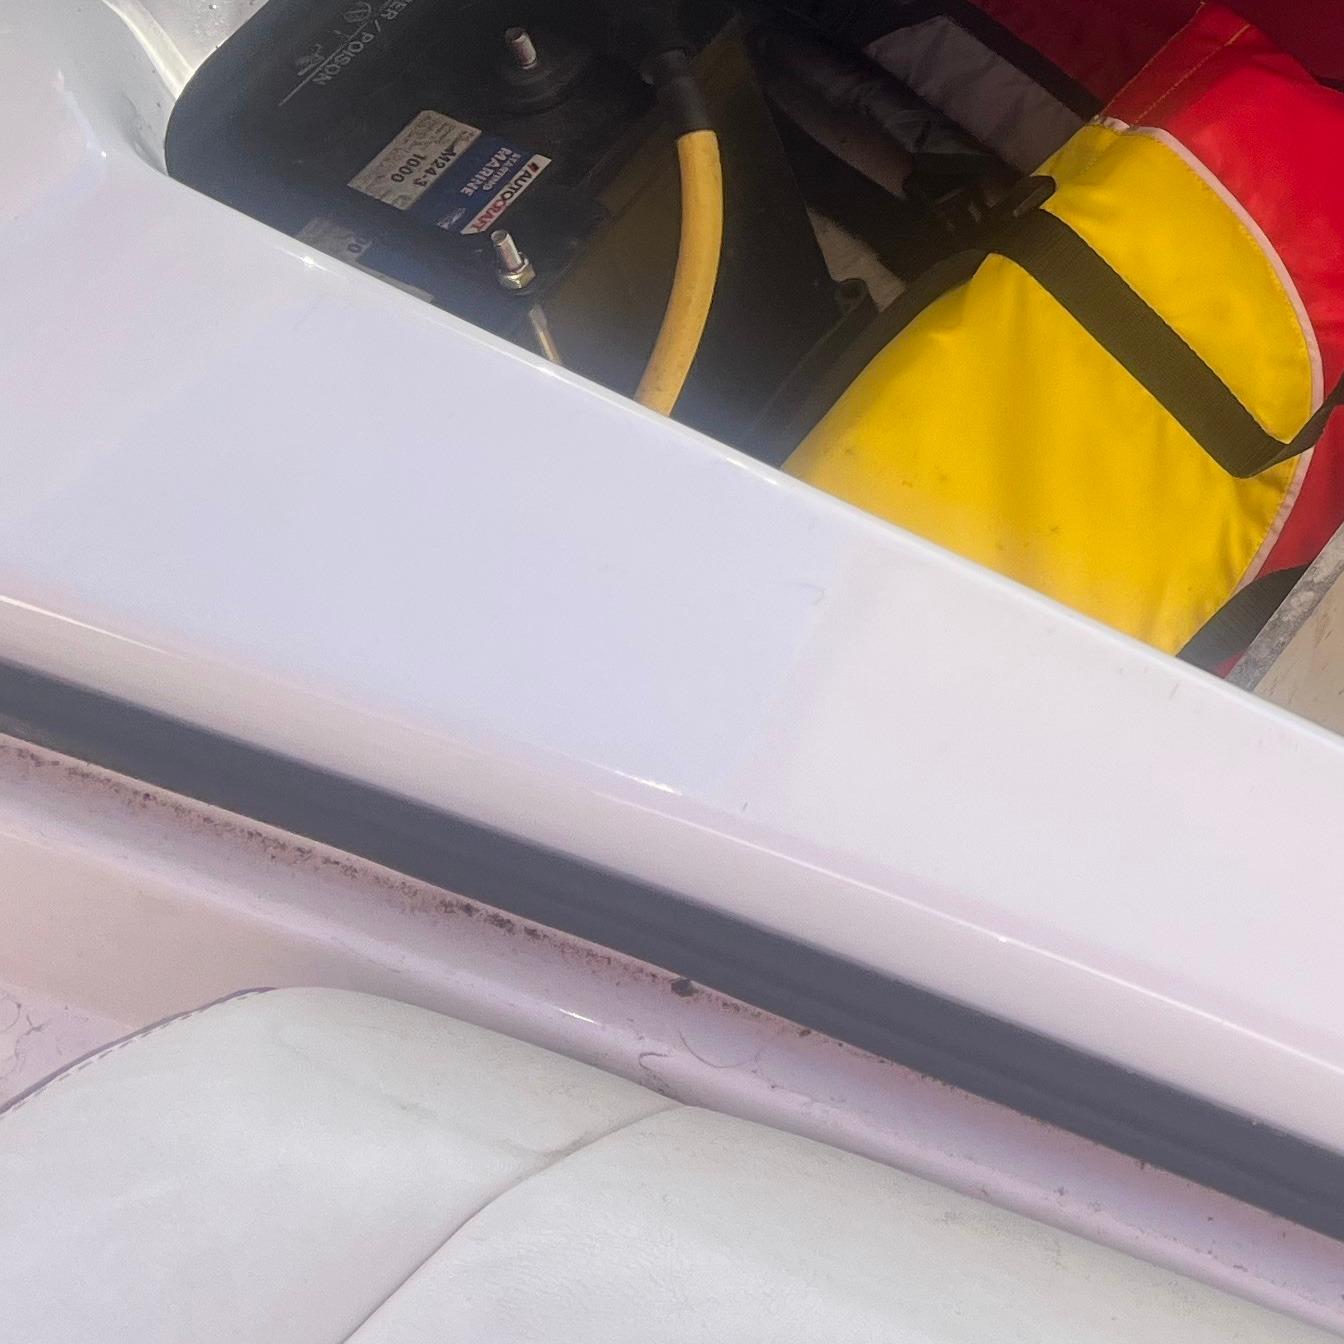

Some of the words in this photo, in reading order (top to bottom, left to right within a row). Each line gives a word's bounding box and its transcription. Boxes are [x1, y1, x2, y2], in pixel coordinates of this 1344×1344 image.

[312, 31, 376, 86] POISON
[391, 153, 426, 183] 1000
[460, 147, 513, 197] MARINE
[469, 169, 533, 232] AUTOCRAFT
